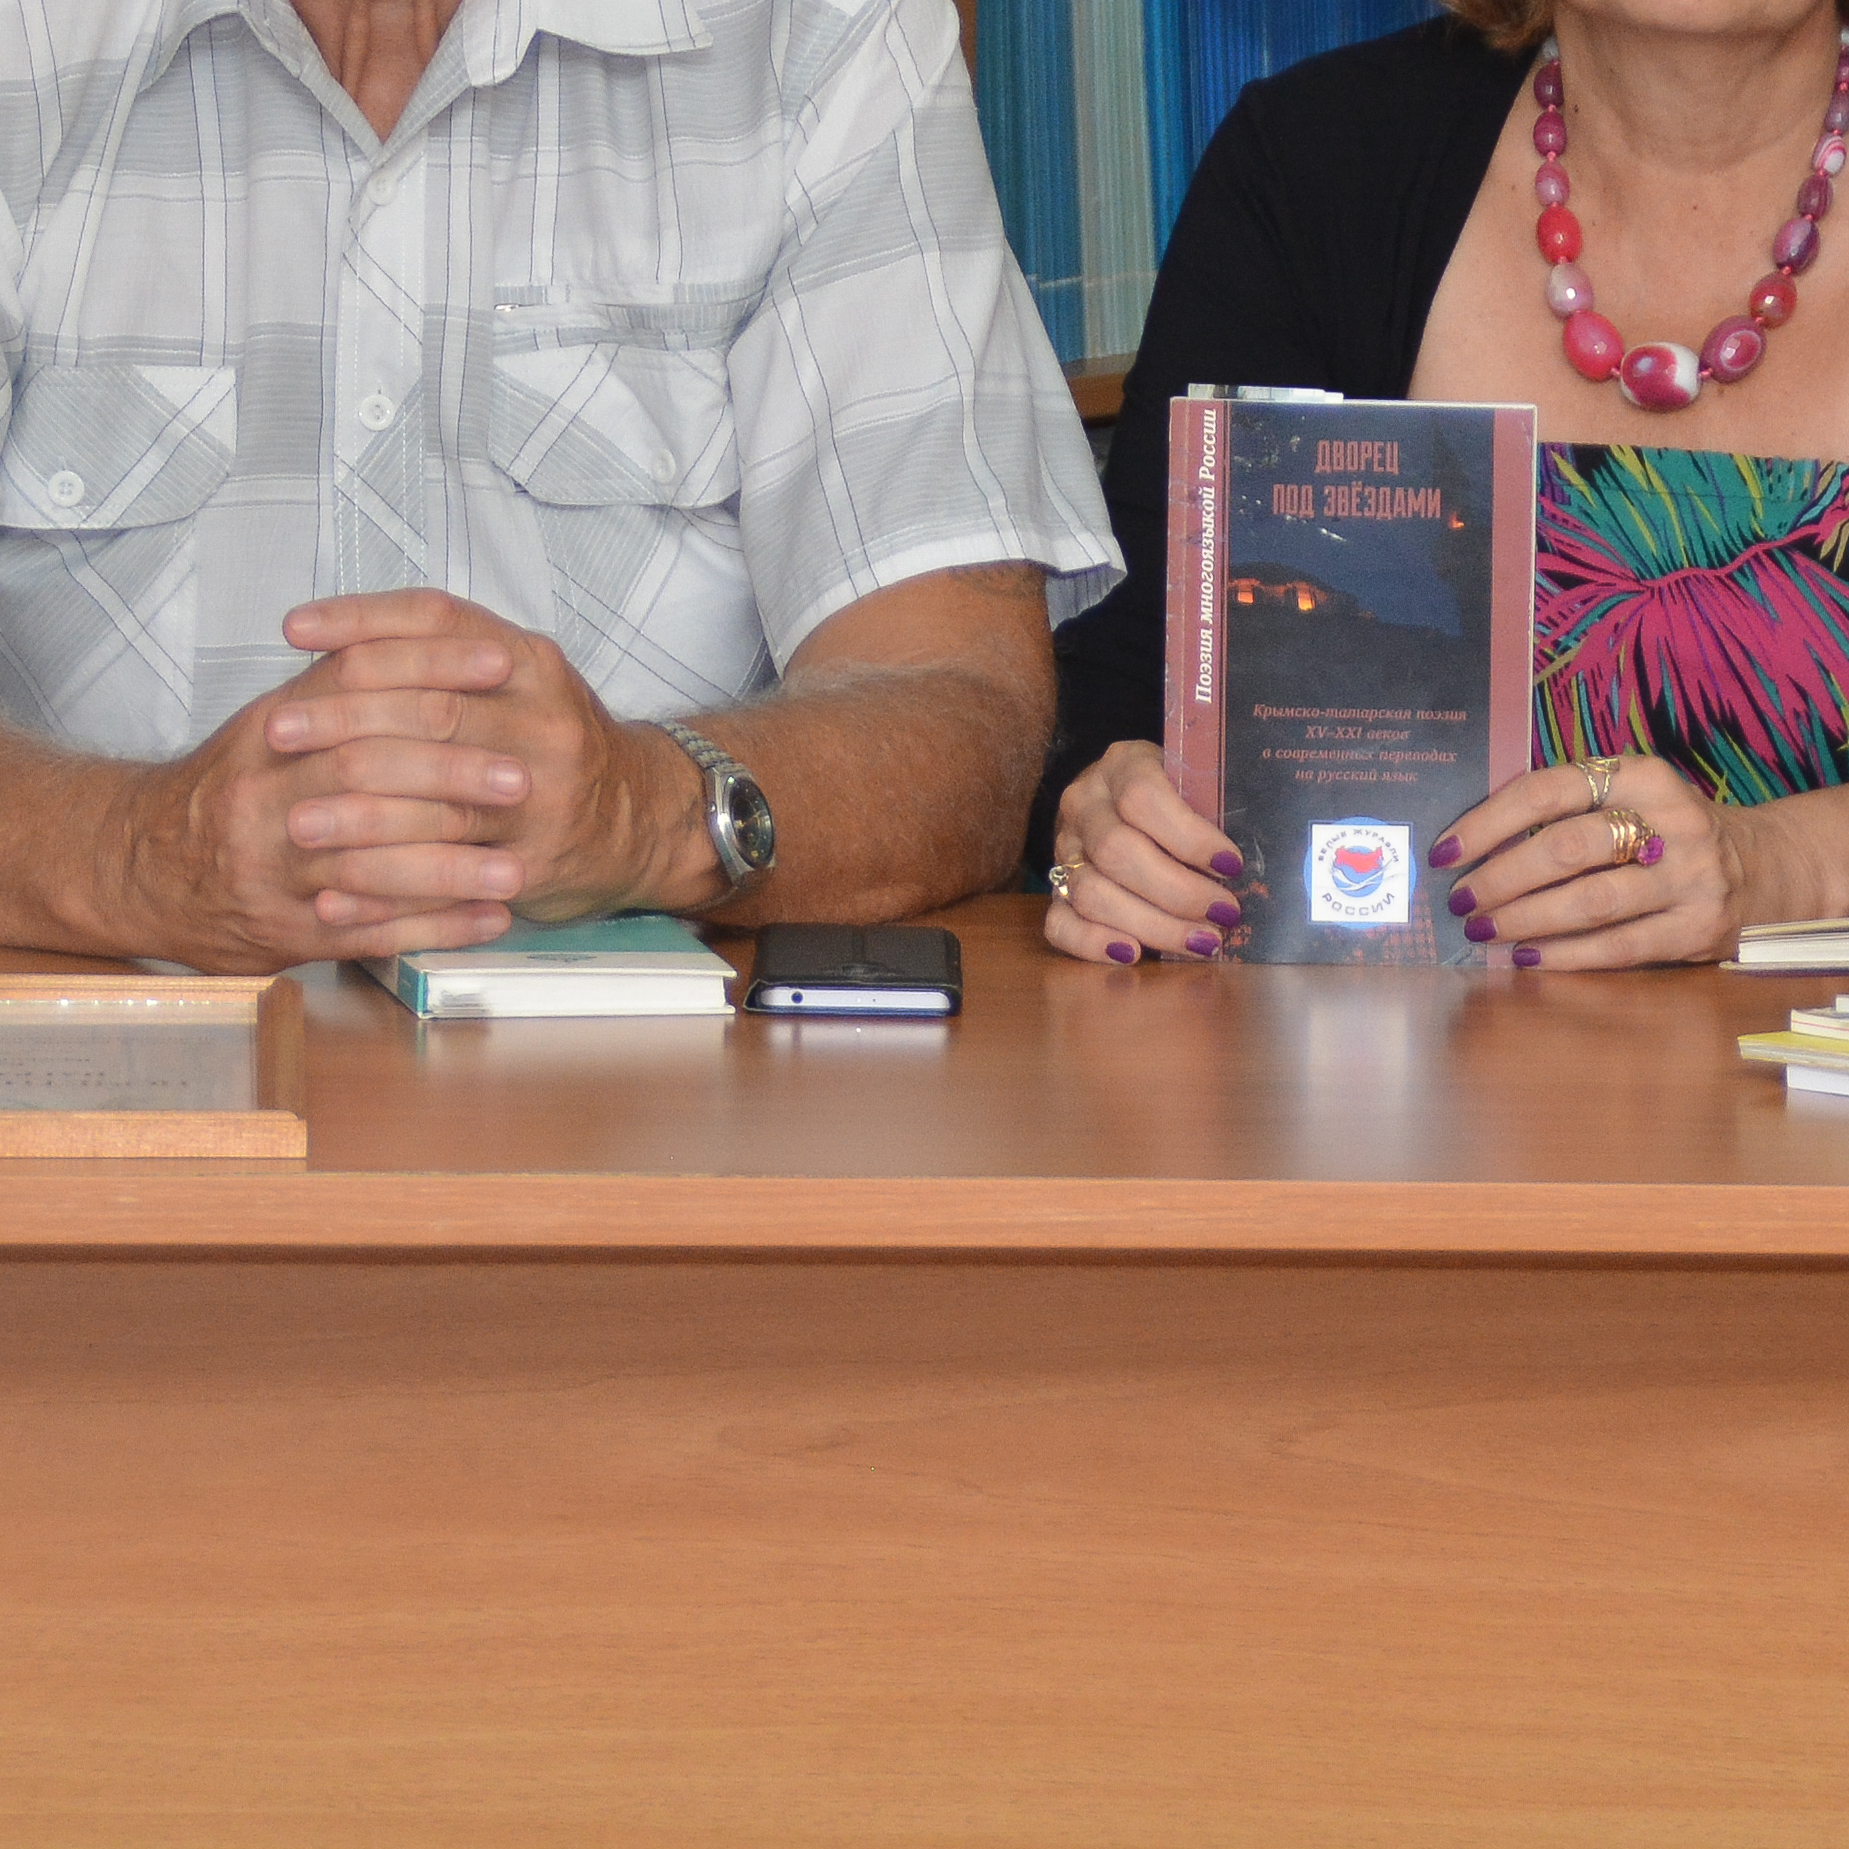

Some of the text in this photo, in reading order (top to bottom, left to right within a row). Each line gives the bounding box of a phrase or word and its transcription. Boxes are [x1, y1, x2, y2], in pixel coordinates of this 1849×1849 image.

[1315, 439, 1399, 475] ДВОРЕЦ
[1273, 480, 1442, 520] ПОД ЗВЁЗДАМИ
[1195, 408, 1217, 704] Поэзия многоязыкой России
[1252, 703, 1468, 722] Крымско-татарская поэзия
[1275, 748, 1374, 762] современных
[1295, 768, 1419, 784] на русский язык
[1322, 892, 1395, 916] РОССИИ
